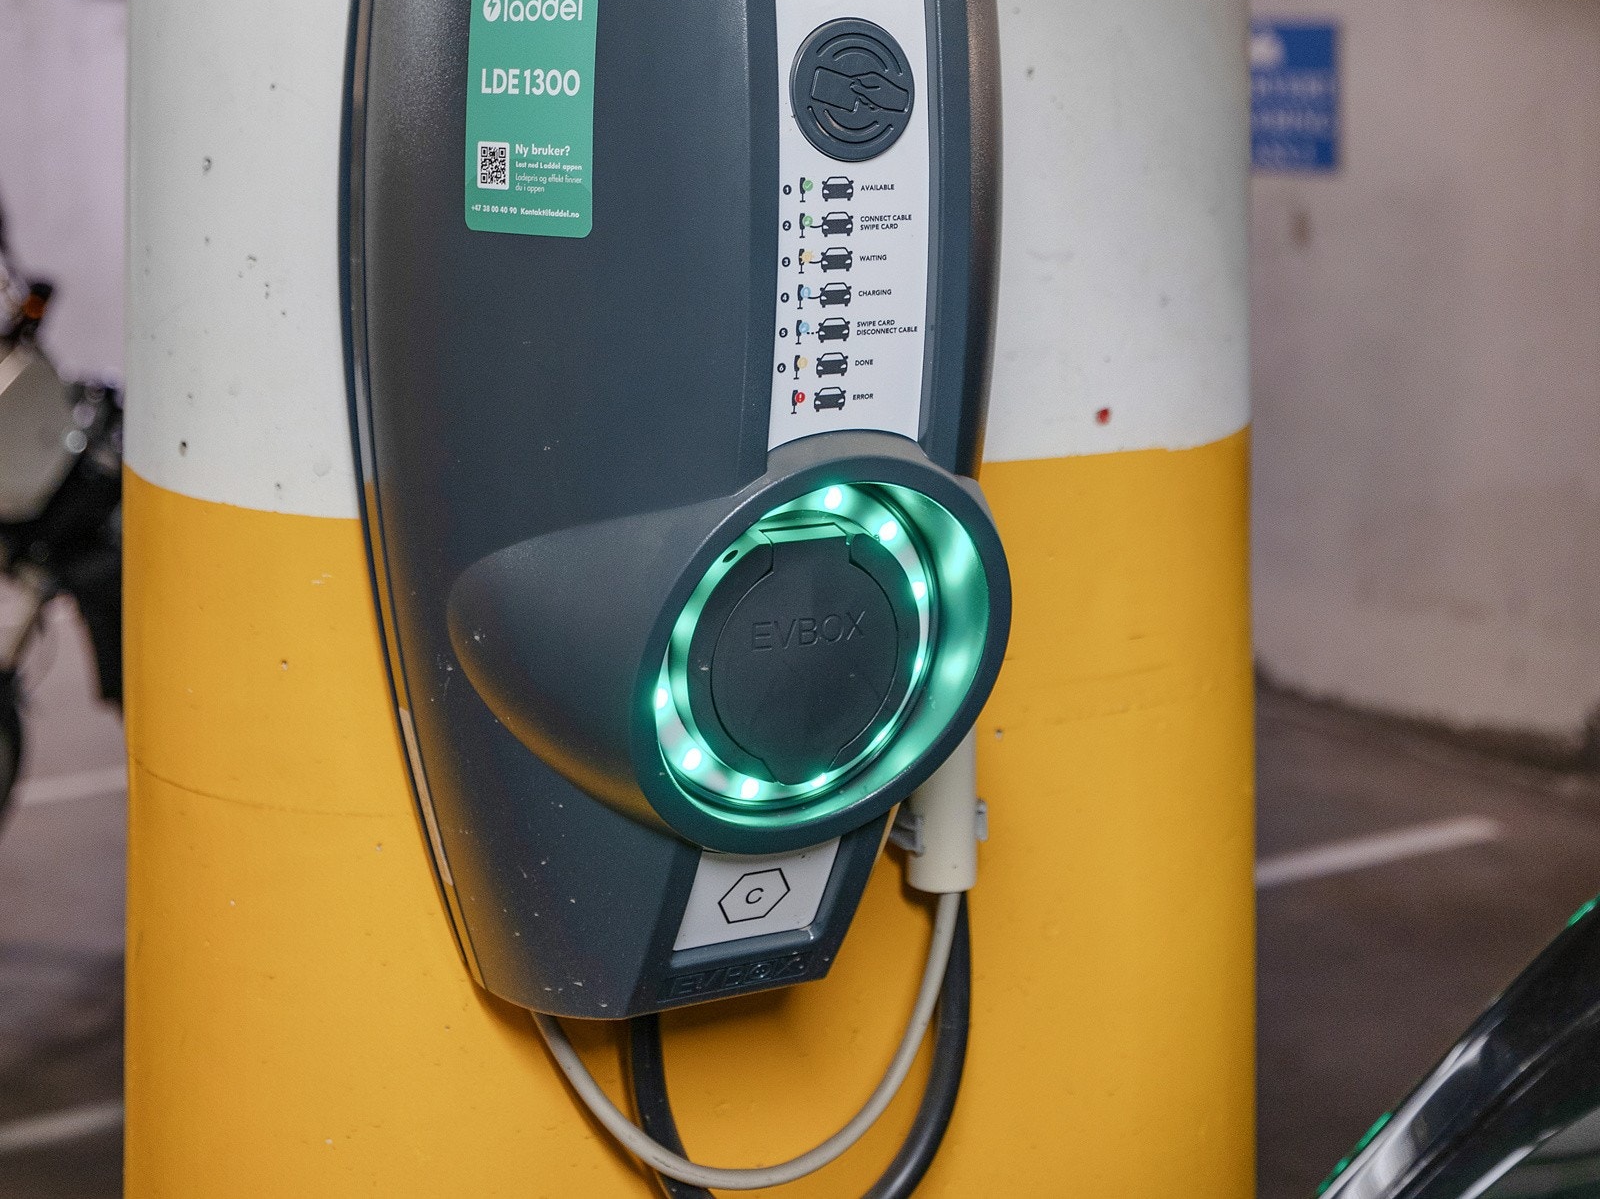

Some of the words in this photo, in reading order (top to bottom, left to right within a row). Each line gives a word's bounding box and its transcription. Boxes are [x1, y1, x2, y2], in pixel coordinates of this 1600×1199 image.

[515, 144, 529, 157] Ny
[531, 144, 570, 156] bruker?
[540, 161, 560, 170] Laddel
[562, 163, 582, 172] appen
[515, 173, 538, 183] Ladepris
[539, 176, 547, 184] og
[548, 174, 564, 183] effekt
[564, 174, 582, 184] finner
[526, 185, 545, 193] appen
[471, 204, 481, 212] +47
[491, 205, 499, 213] 00
[500, 206, 508, 214] 40
[509, 206, 518, 215] 90
[877, 319, 896, 327] CARD
[856, 328, 897, 336] DISCONNECT
[752, 610, 866, 652] EVBOX
[745, 887, 764, 905] C
